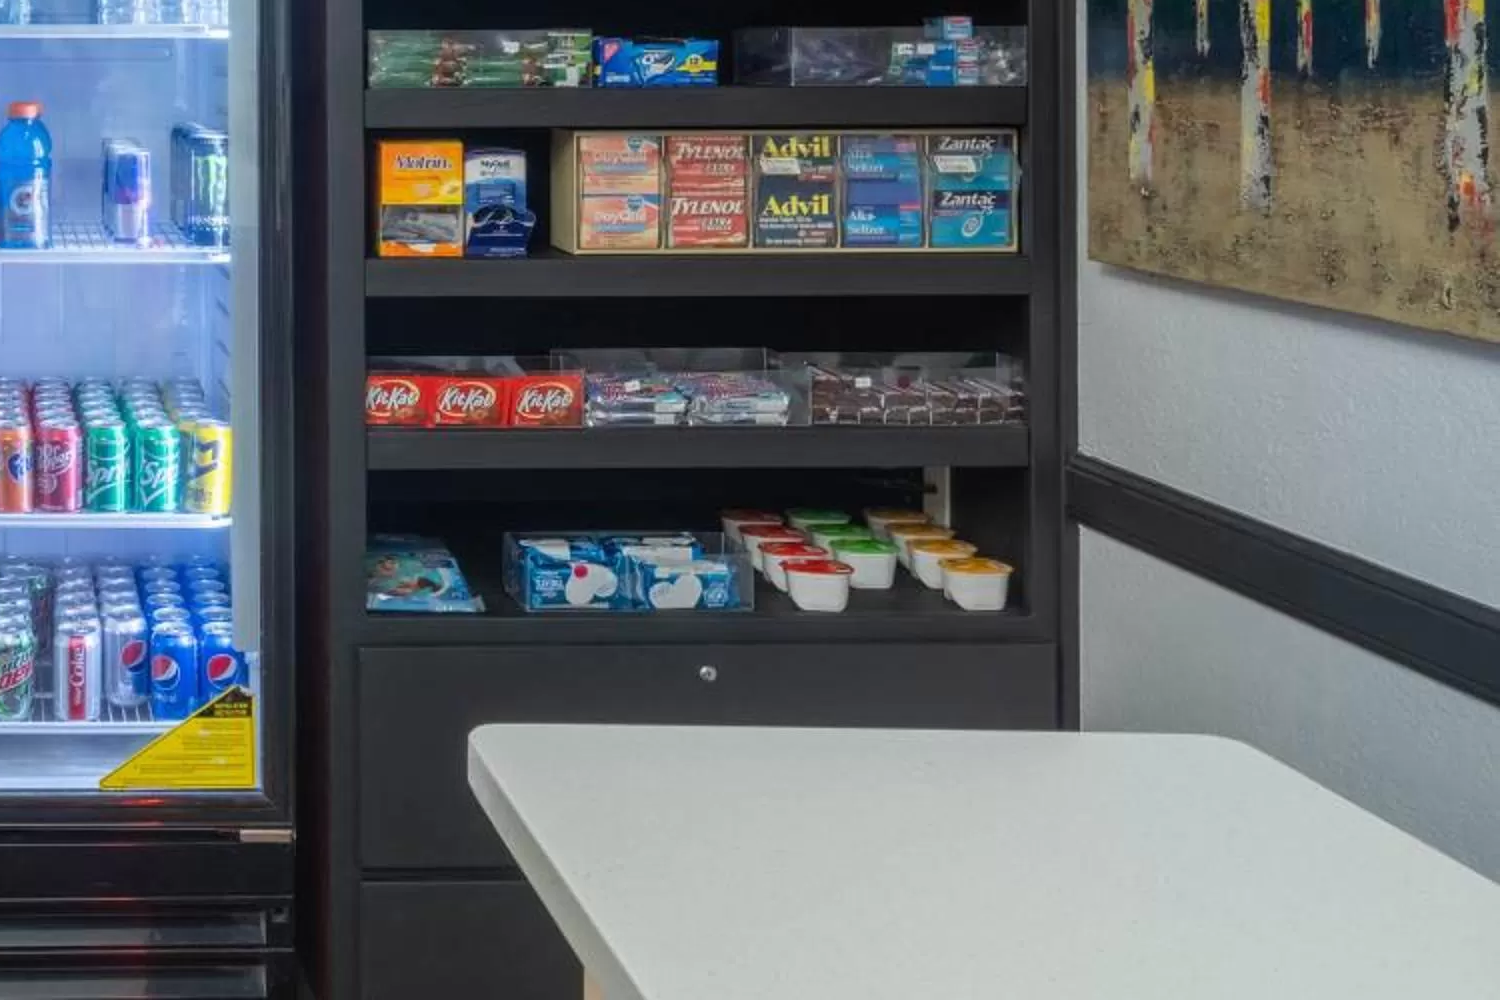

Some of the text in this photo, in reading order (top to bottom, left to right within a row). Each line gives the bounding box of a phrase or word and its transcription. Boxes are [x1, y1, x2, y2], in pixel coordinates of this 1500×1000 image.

[675, 141, 745, 160] TYLENOL
[762, 135, 831, 158] Advil
[940, 135, 996, 152] Zantac
[671, 197, 744, 215] TYLENOL
[761, 194, 830, 216] Advil
[941, 191, 996, 206] Zantac
